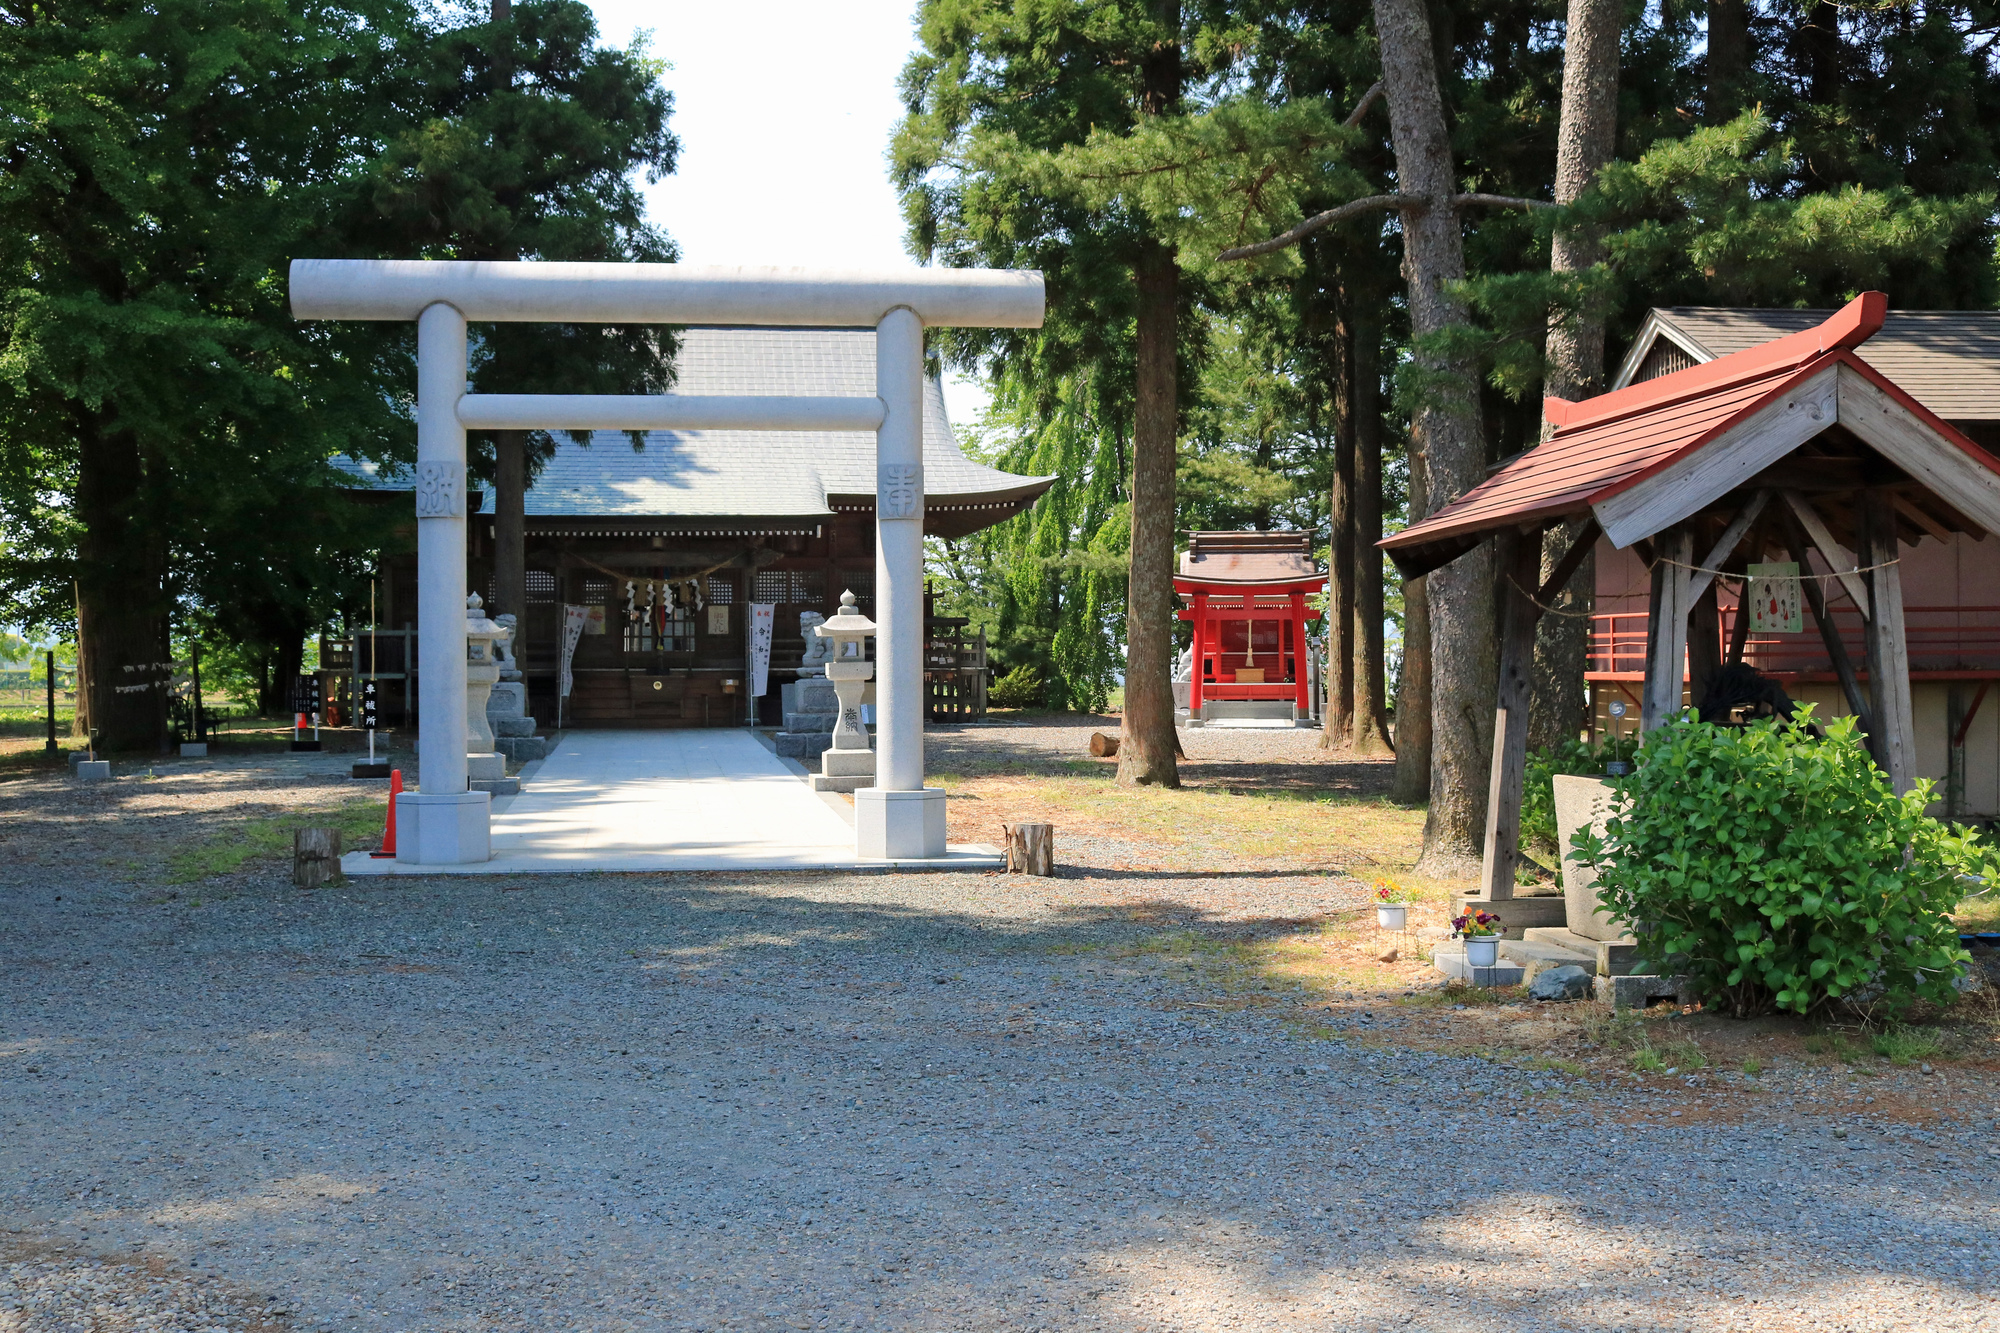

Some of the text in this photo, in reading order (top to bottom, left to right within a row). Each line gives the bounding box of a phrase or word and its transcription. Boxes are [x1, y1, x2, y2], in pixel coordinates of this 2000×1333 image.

[365, 683, 377, 727] 車祓所
[844, 707, 858, 732] 奉納
